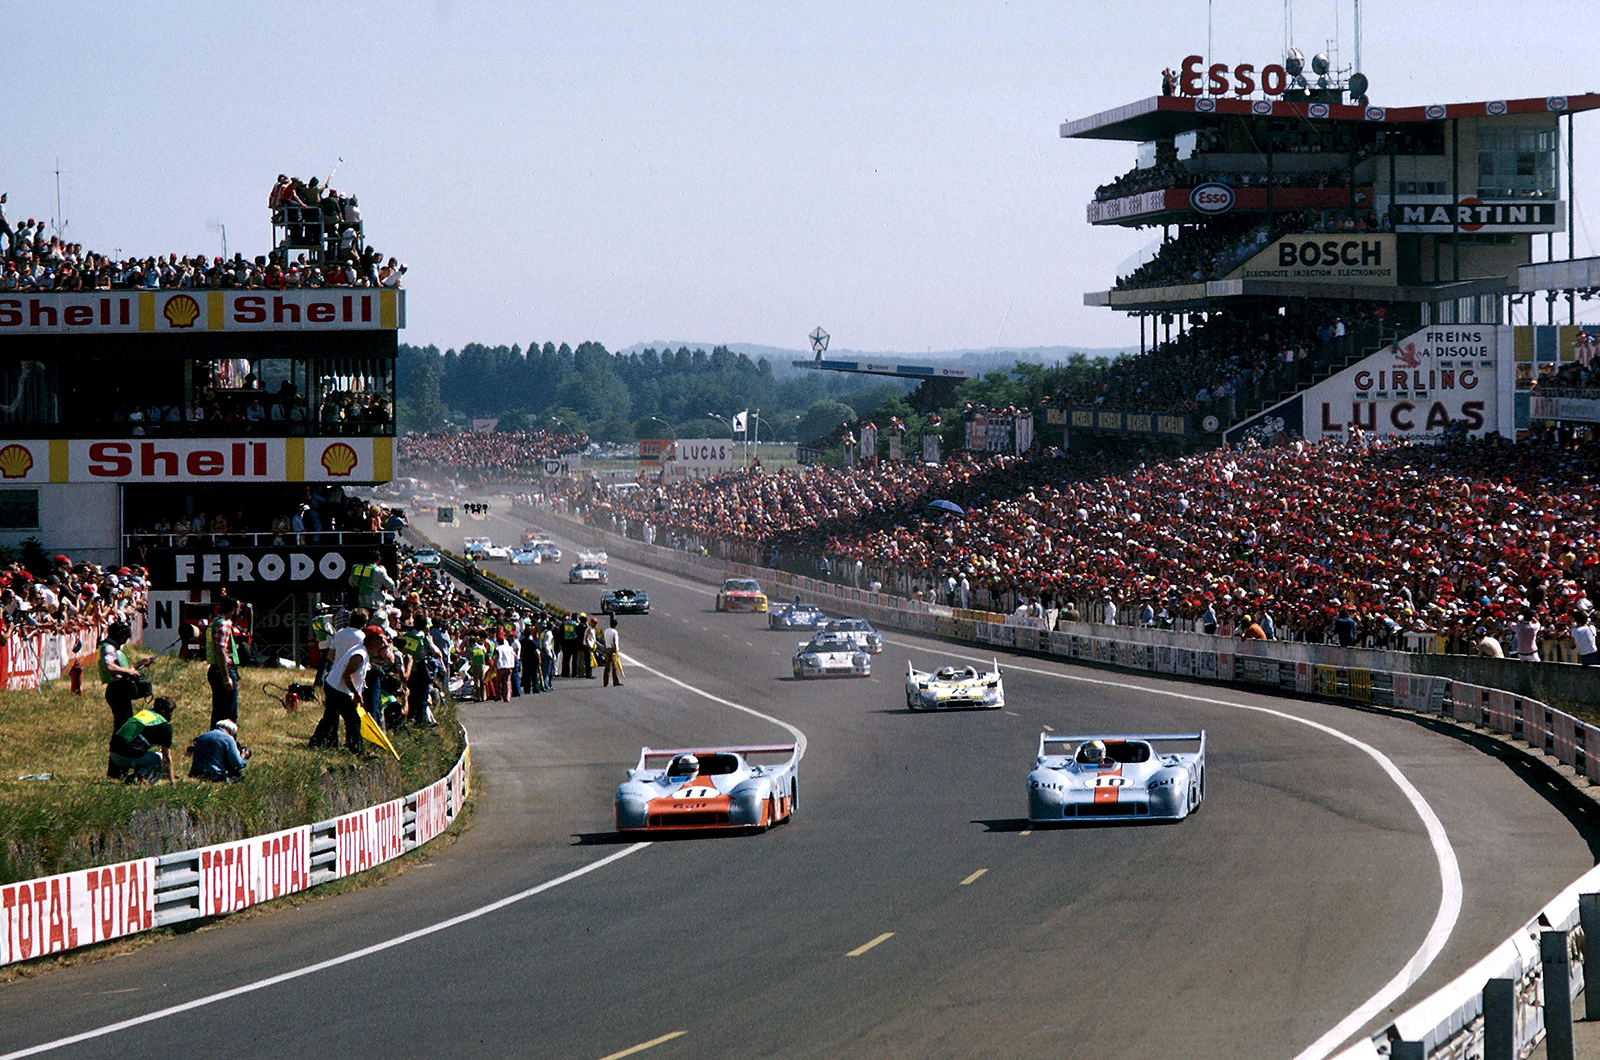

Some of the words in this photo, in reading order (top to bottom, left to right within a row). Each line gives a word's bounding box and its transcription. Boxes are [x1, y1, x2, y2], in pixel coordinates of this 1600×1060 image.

[1403, 206, 1541, 223] MARTINI
[1278, 241, 1382, 267] BOSCH
[1294, 270, 1331, 278] INJECTION
[0, 298, 130, 327] Shell
[233, 295, 372, 324] Shell
[1426, 332, 1482, 342] FREINS
[1436, 346, 1487, 357] DISQUE
[1354, 370, 1479, 391] GIRLING
[1321, 400, 1485, 432] LUCAS
[88, 442, 267, 477] Shell
[683, 446, 726, 460] LUCAS
[546, 462, 559, 474] BP
[174, 552, 346, 583] FERODO
[685, 789, 707, 798] 11
[337, 812, 373, 878] TOTAL
[375, 800, 401, 864] TOTAL
[262, 829, 308, 900] TOTAL
[202, 844, 256, 916] TOTAL
[87, 861, 153, 943] TOTAL
[2, 876, 78, 963] TOTAL
